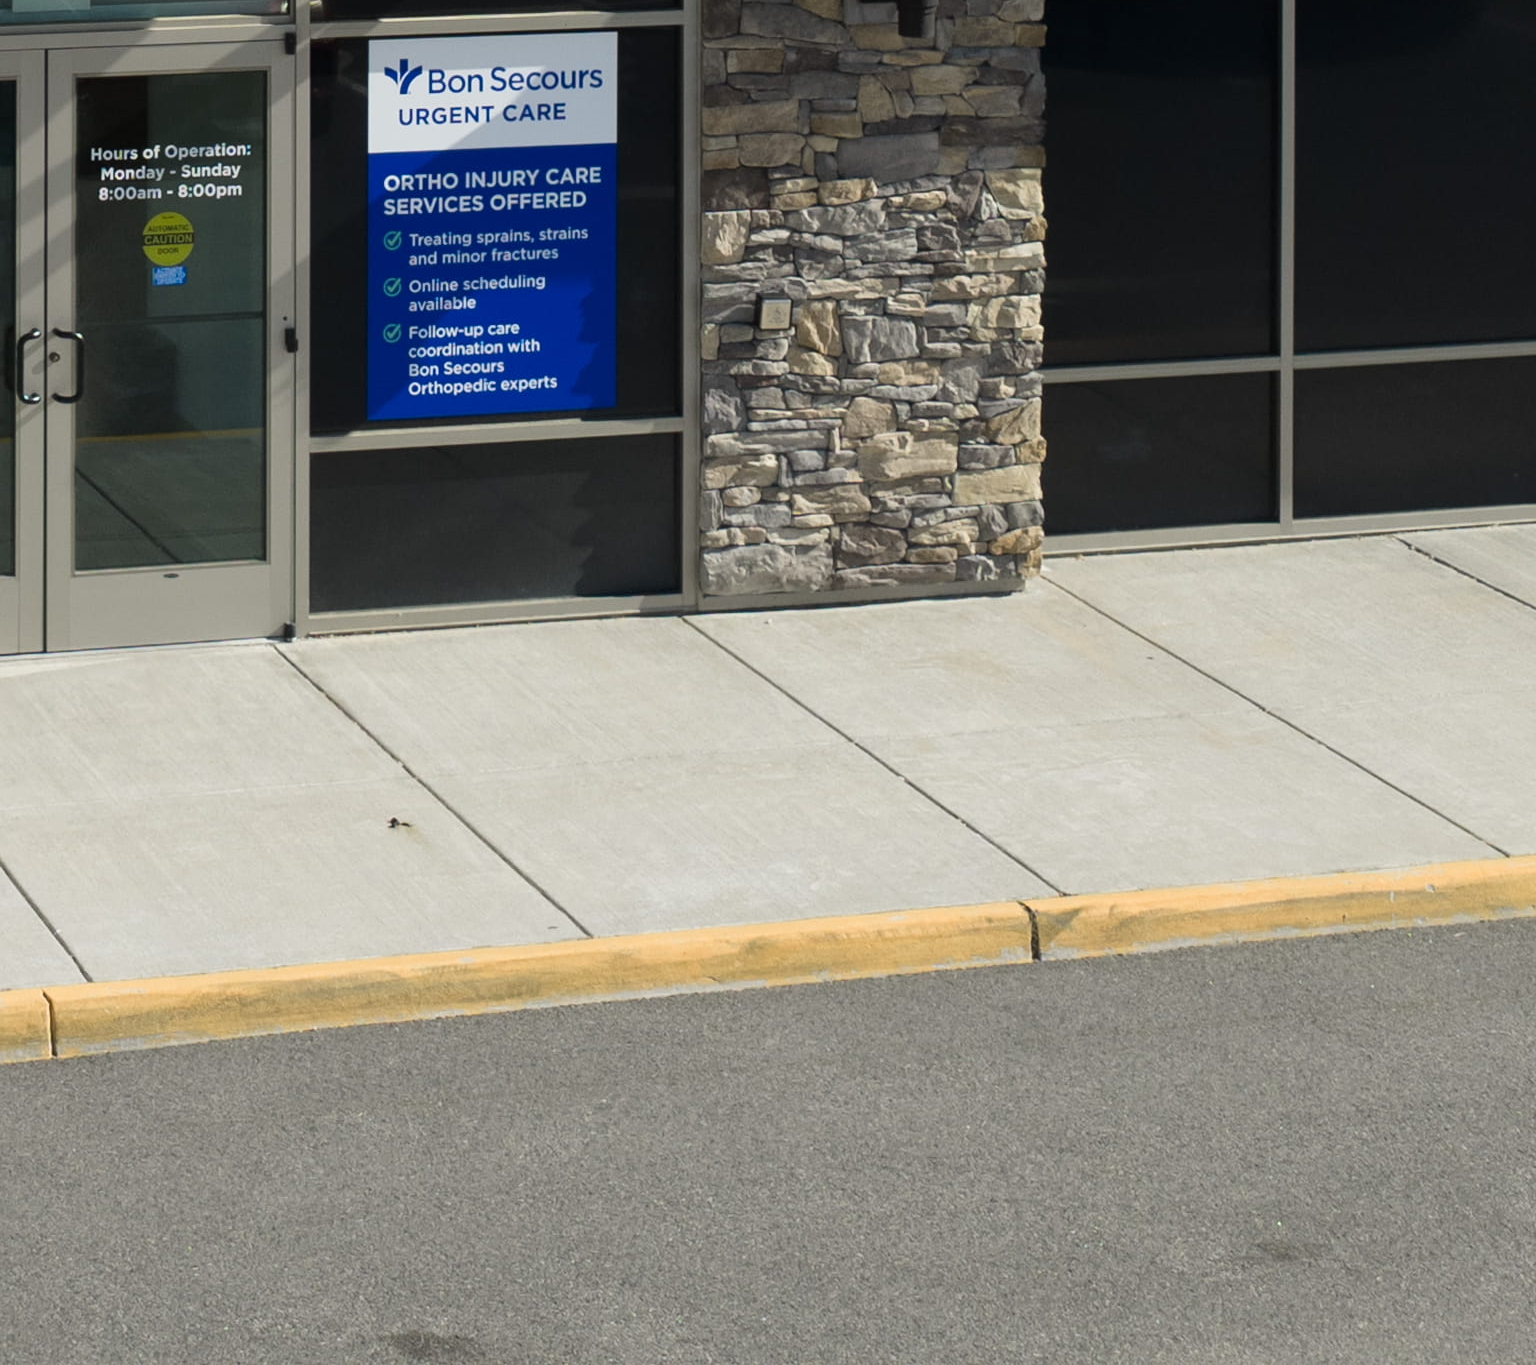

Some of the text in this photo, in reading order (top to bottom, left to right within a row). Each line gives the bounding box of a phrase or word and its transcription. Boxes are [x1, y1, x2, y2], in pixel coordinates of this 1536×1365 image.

[428, 66, 603, 94] Bon Secours
[399, 102, 567, 126] URGENT CARE
[90, 142, 252, 161] Hours of Operation:
[100, 165, 165, 181] Monday
[180, 162, 242, 179] Sunday
[383, 166, 602, 192] ORTHO INJURY CARE
[98, 186, 163, 201] 8:00am
[178, 183, 243, 200] 8:00pm
[383, 191, 587, 216] SERVICES OFFERED
[147, 224, 190, 232] AUTOMATIC
[409, 226, 589, 247] Treating sprains, strains
[144, 234, 193, 245] CAUTION
[157, 247, 179, 255] DOOR
[409, 246, 559, 266] and minor fractures
[409, 275, 546, 293] Online scheduling
[409, 297, 477, 312] available
[409, 323, 520, 340] Follow-up care
[409, 338, 540, 358] coordination with
[409, 360, 505, 377] Bon Secours
[409, 376, 558, 396] Orthopedic experts
